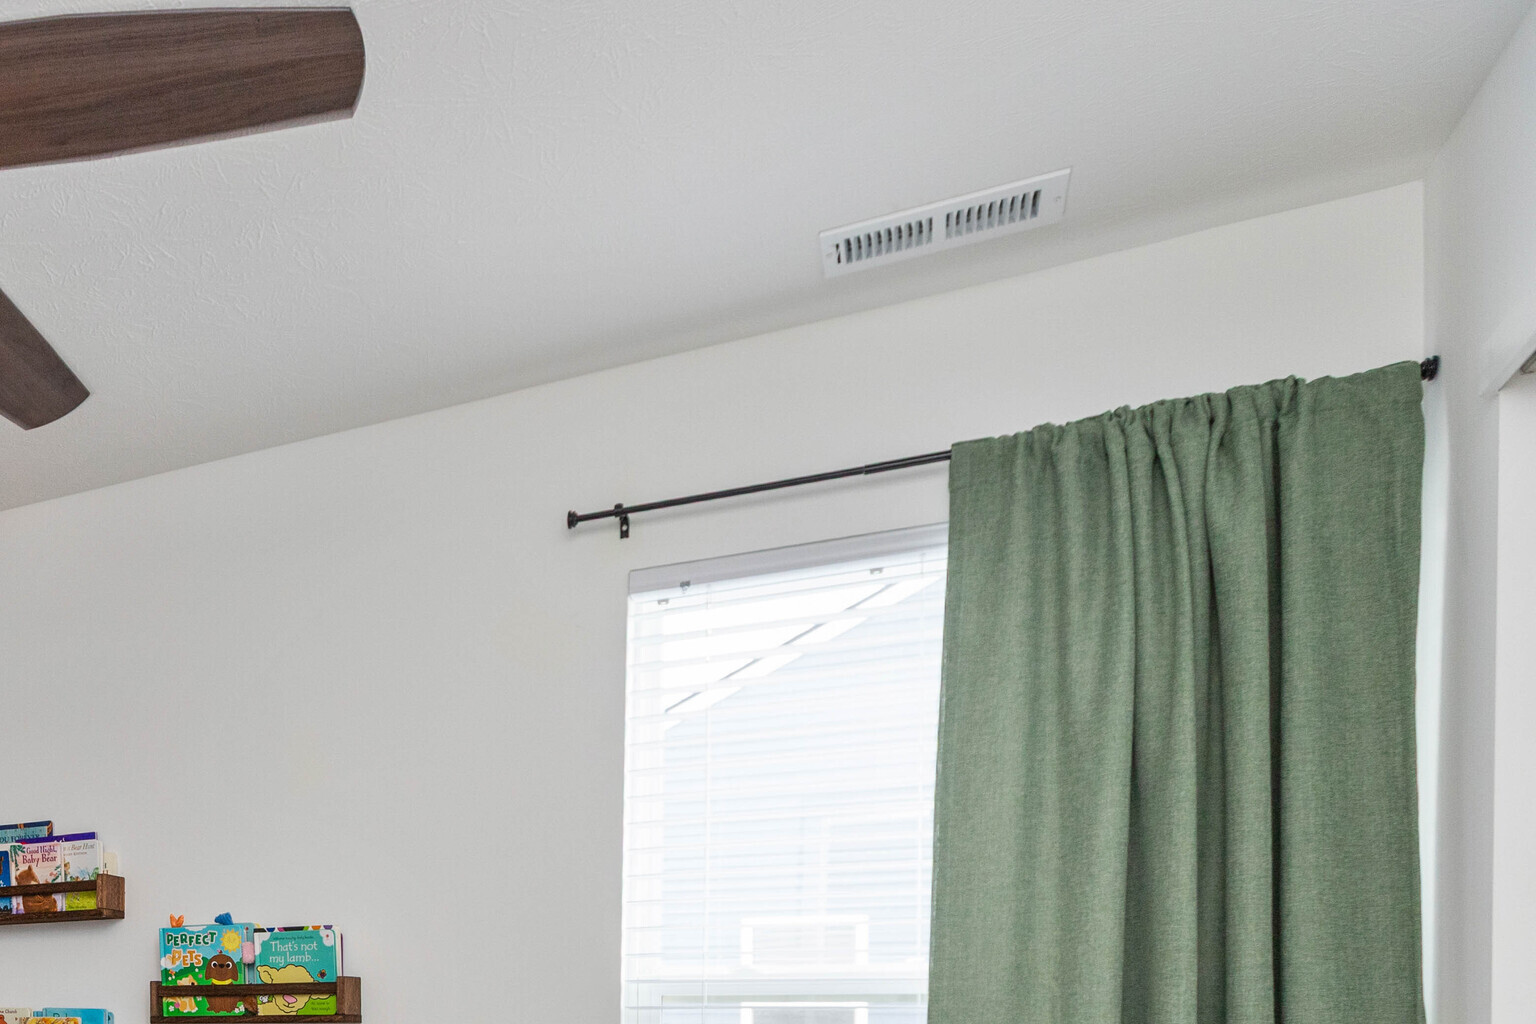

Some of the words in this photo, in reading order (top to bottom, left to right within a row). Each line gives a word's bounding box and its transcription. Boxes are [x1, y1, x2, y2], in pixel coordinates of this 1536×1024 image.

[26, 846, 39, 854] Good
[22, 854, 40, 867] Baby
[41, 853, 57, 863] Bear
[166, 931, 217, 946] PERFECT
[269, 940, 299, 951] That's
[300, 941, 318, 951] not
[170, 949, 202, 966] PETS
[269, 955, 285, 967] my
[286, 951, 320, 962] lamb...
